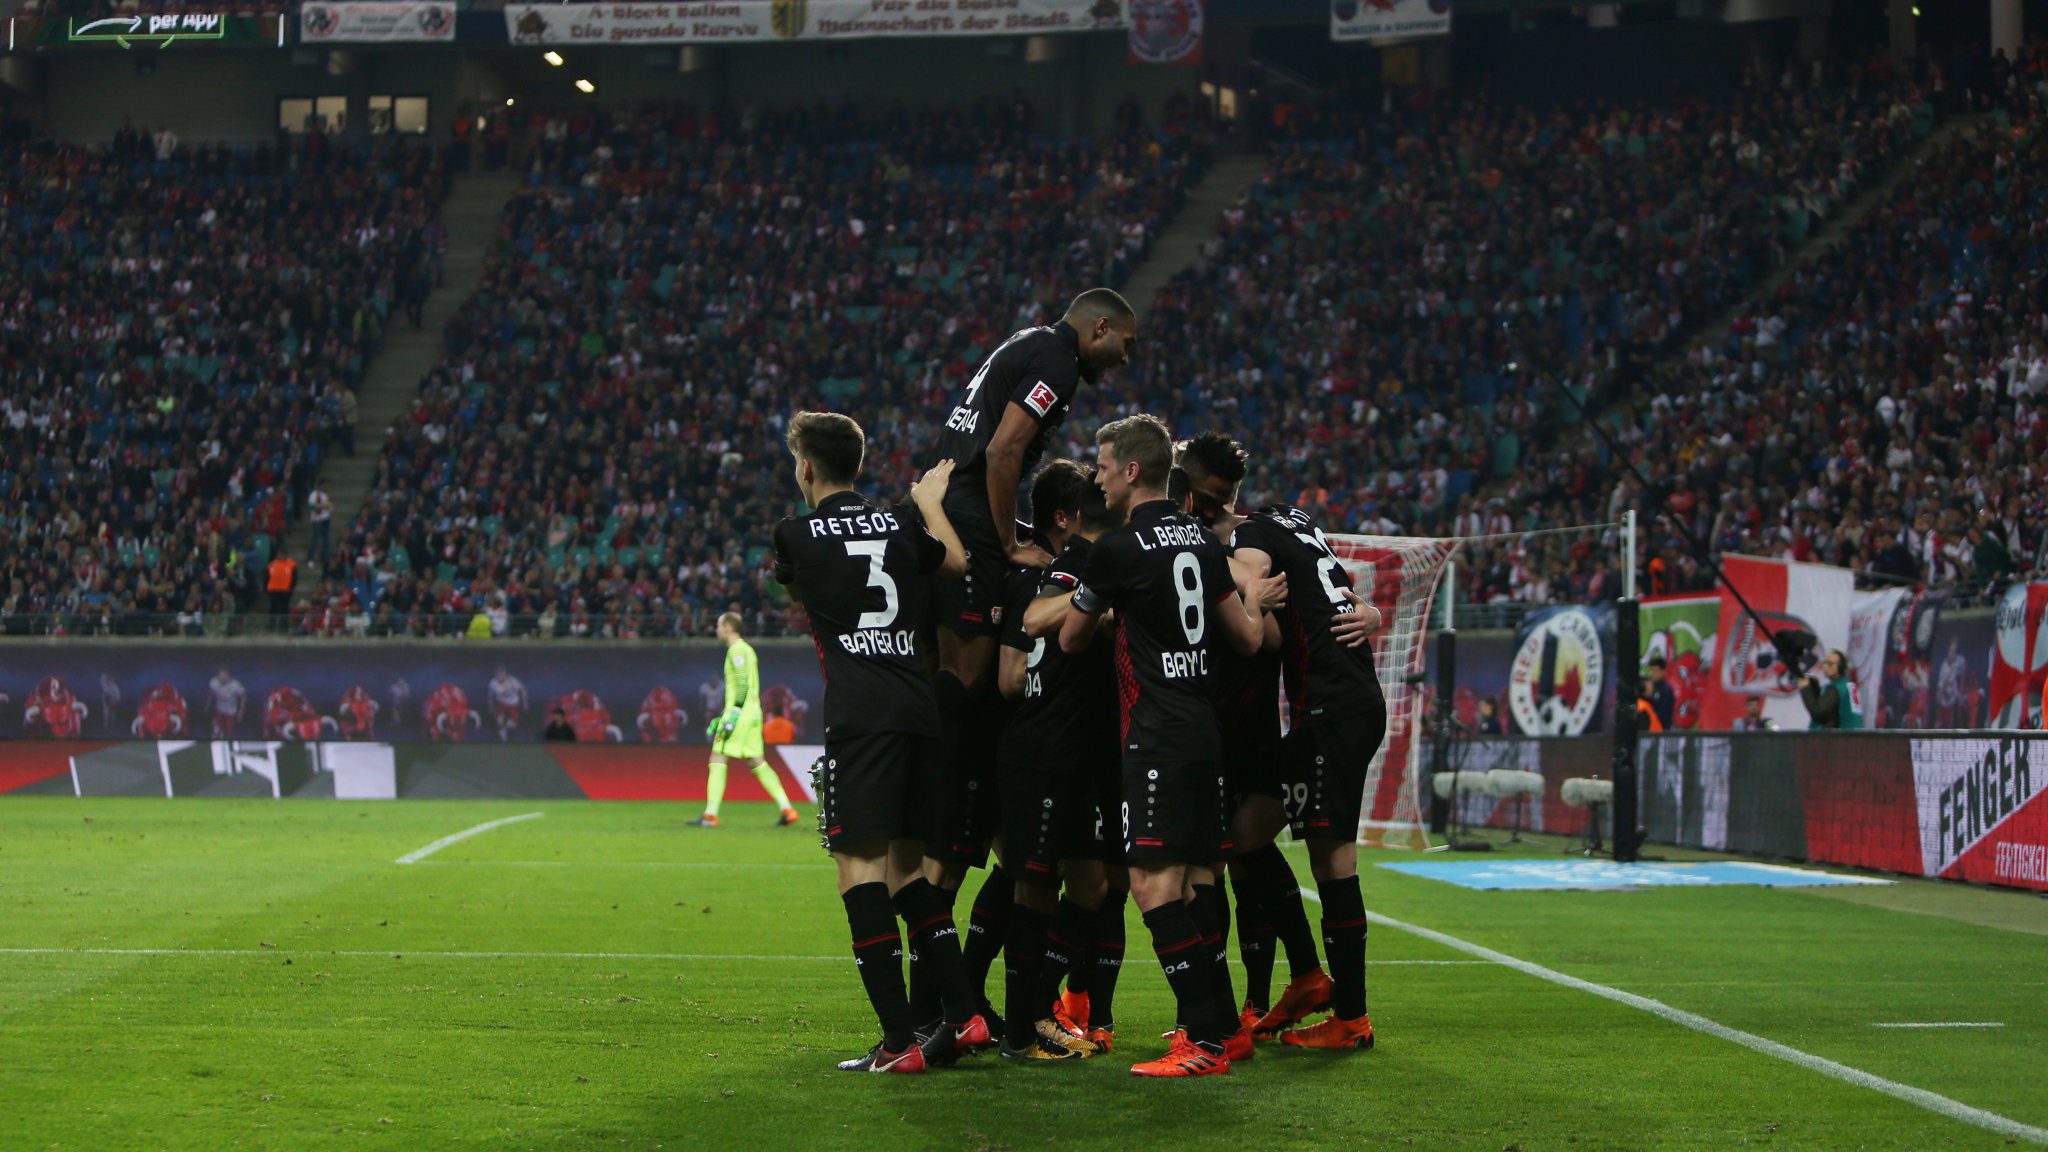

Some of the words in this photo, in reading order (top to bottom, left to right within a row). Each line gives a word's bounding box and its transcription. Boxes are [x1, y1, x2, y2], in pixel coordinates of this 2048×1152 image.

[149, 14, 179, 34] per
[809, 512, 900, 538] RETSOS
[1153, 523, 1206, 547] BENDER
[843, 538, 899, 629] 3
[1172, 551, 1205, 646] 8
[838, 629, 896, 656] BAYER
[1514, 638, 1539, 683] RED
[1560, 614, 1598, 685] CAMPUS
[1281, 782, 1309, 819] 29
[1939, 739, 2031, 867] FENGER
[1045, 949, 1069, 964] JAKO
[1096, 957, 1121, 967] JAKO
[1165, 960, 1190, 975] 04
